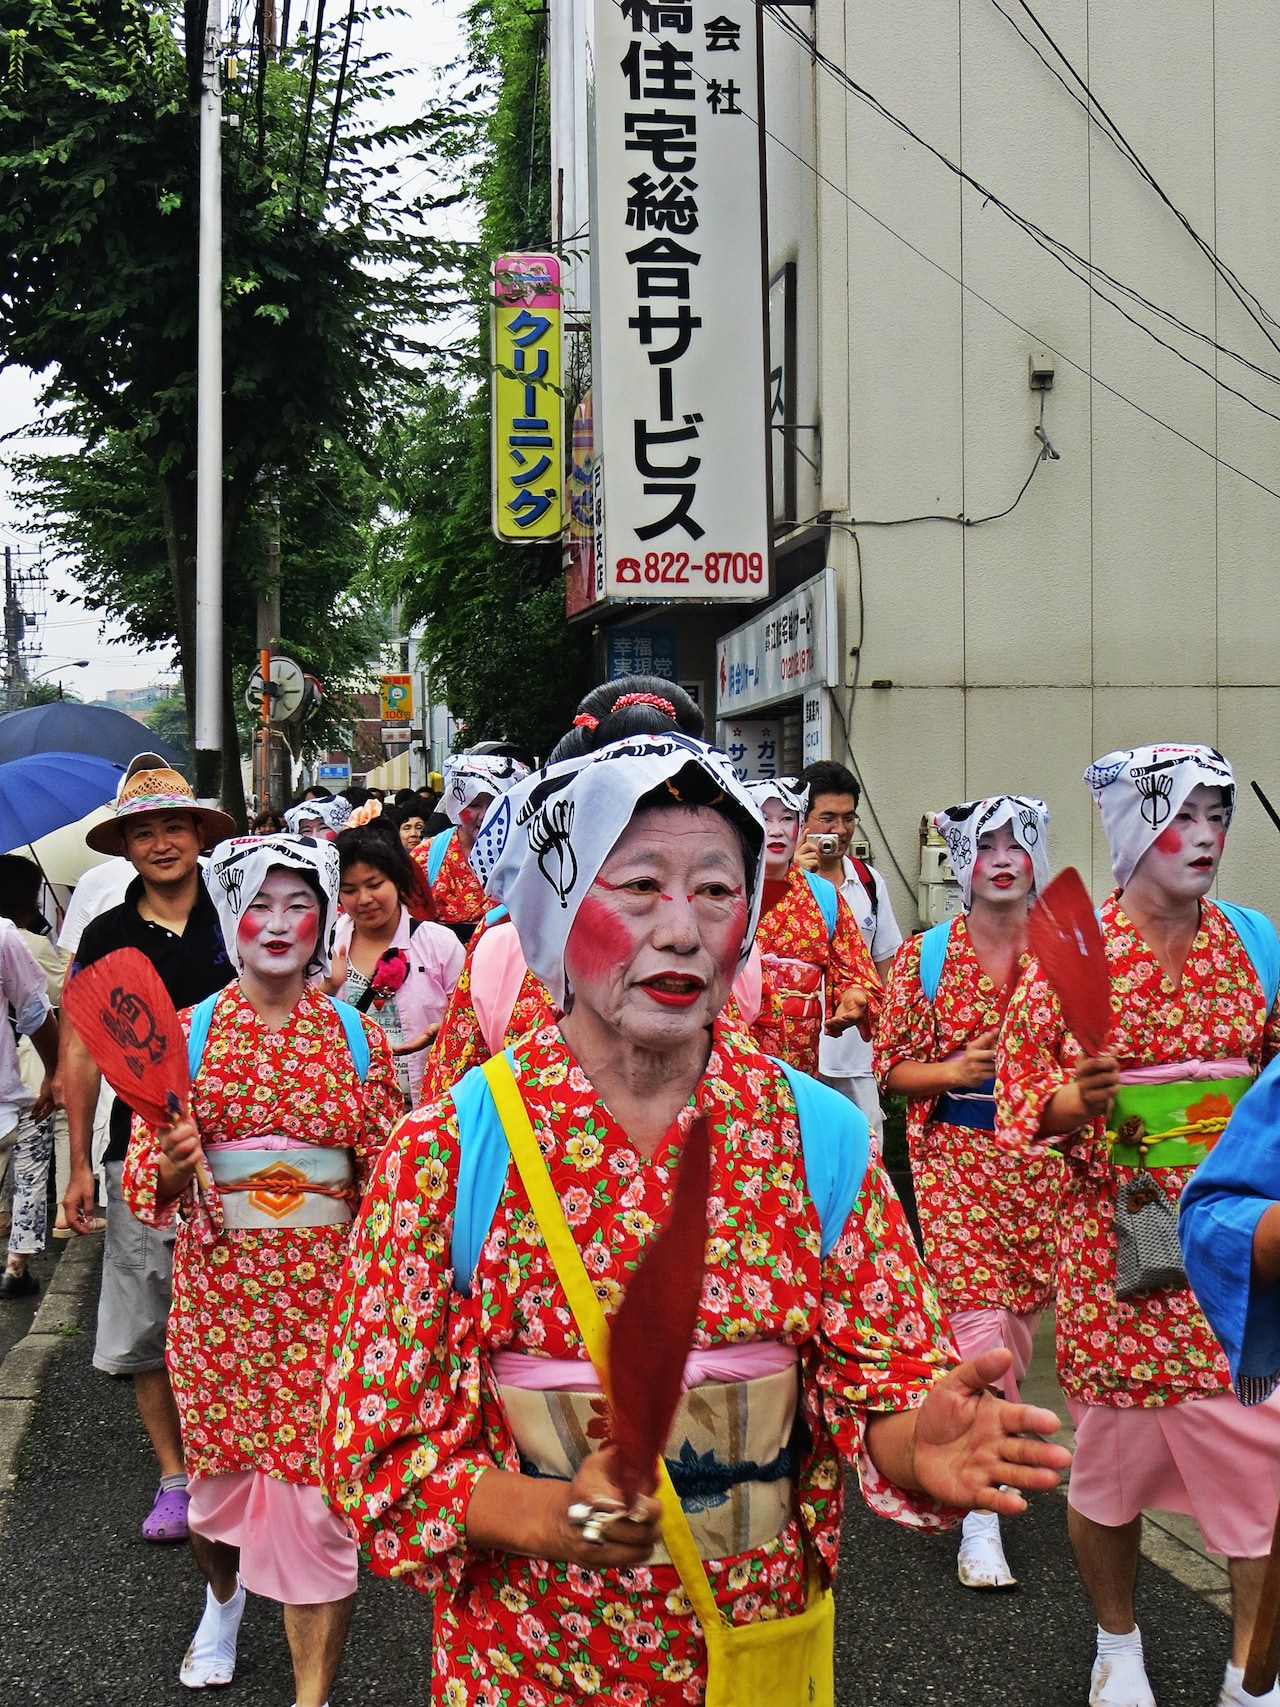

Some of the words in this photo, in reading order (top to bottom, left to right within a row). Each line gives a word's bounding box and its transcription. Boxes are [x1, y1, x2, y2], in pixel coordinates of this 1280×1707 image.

[505, 309, 557, 529] クリーニング
[645, 552, 763, 584] 822-8709
[614, 637, 652, 657] 幸福
[614, 657, 673, 678] 実現党
